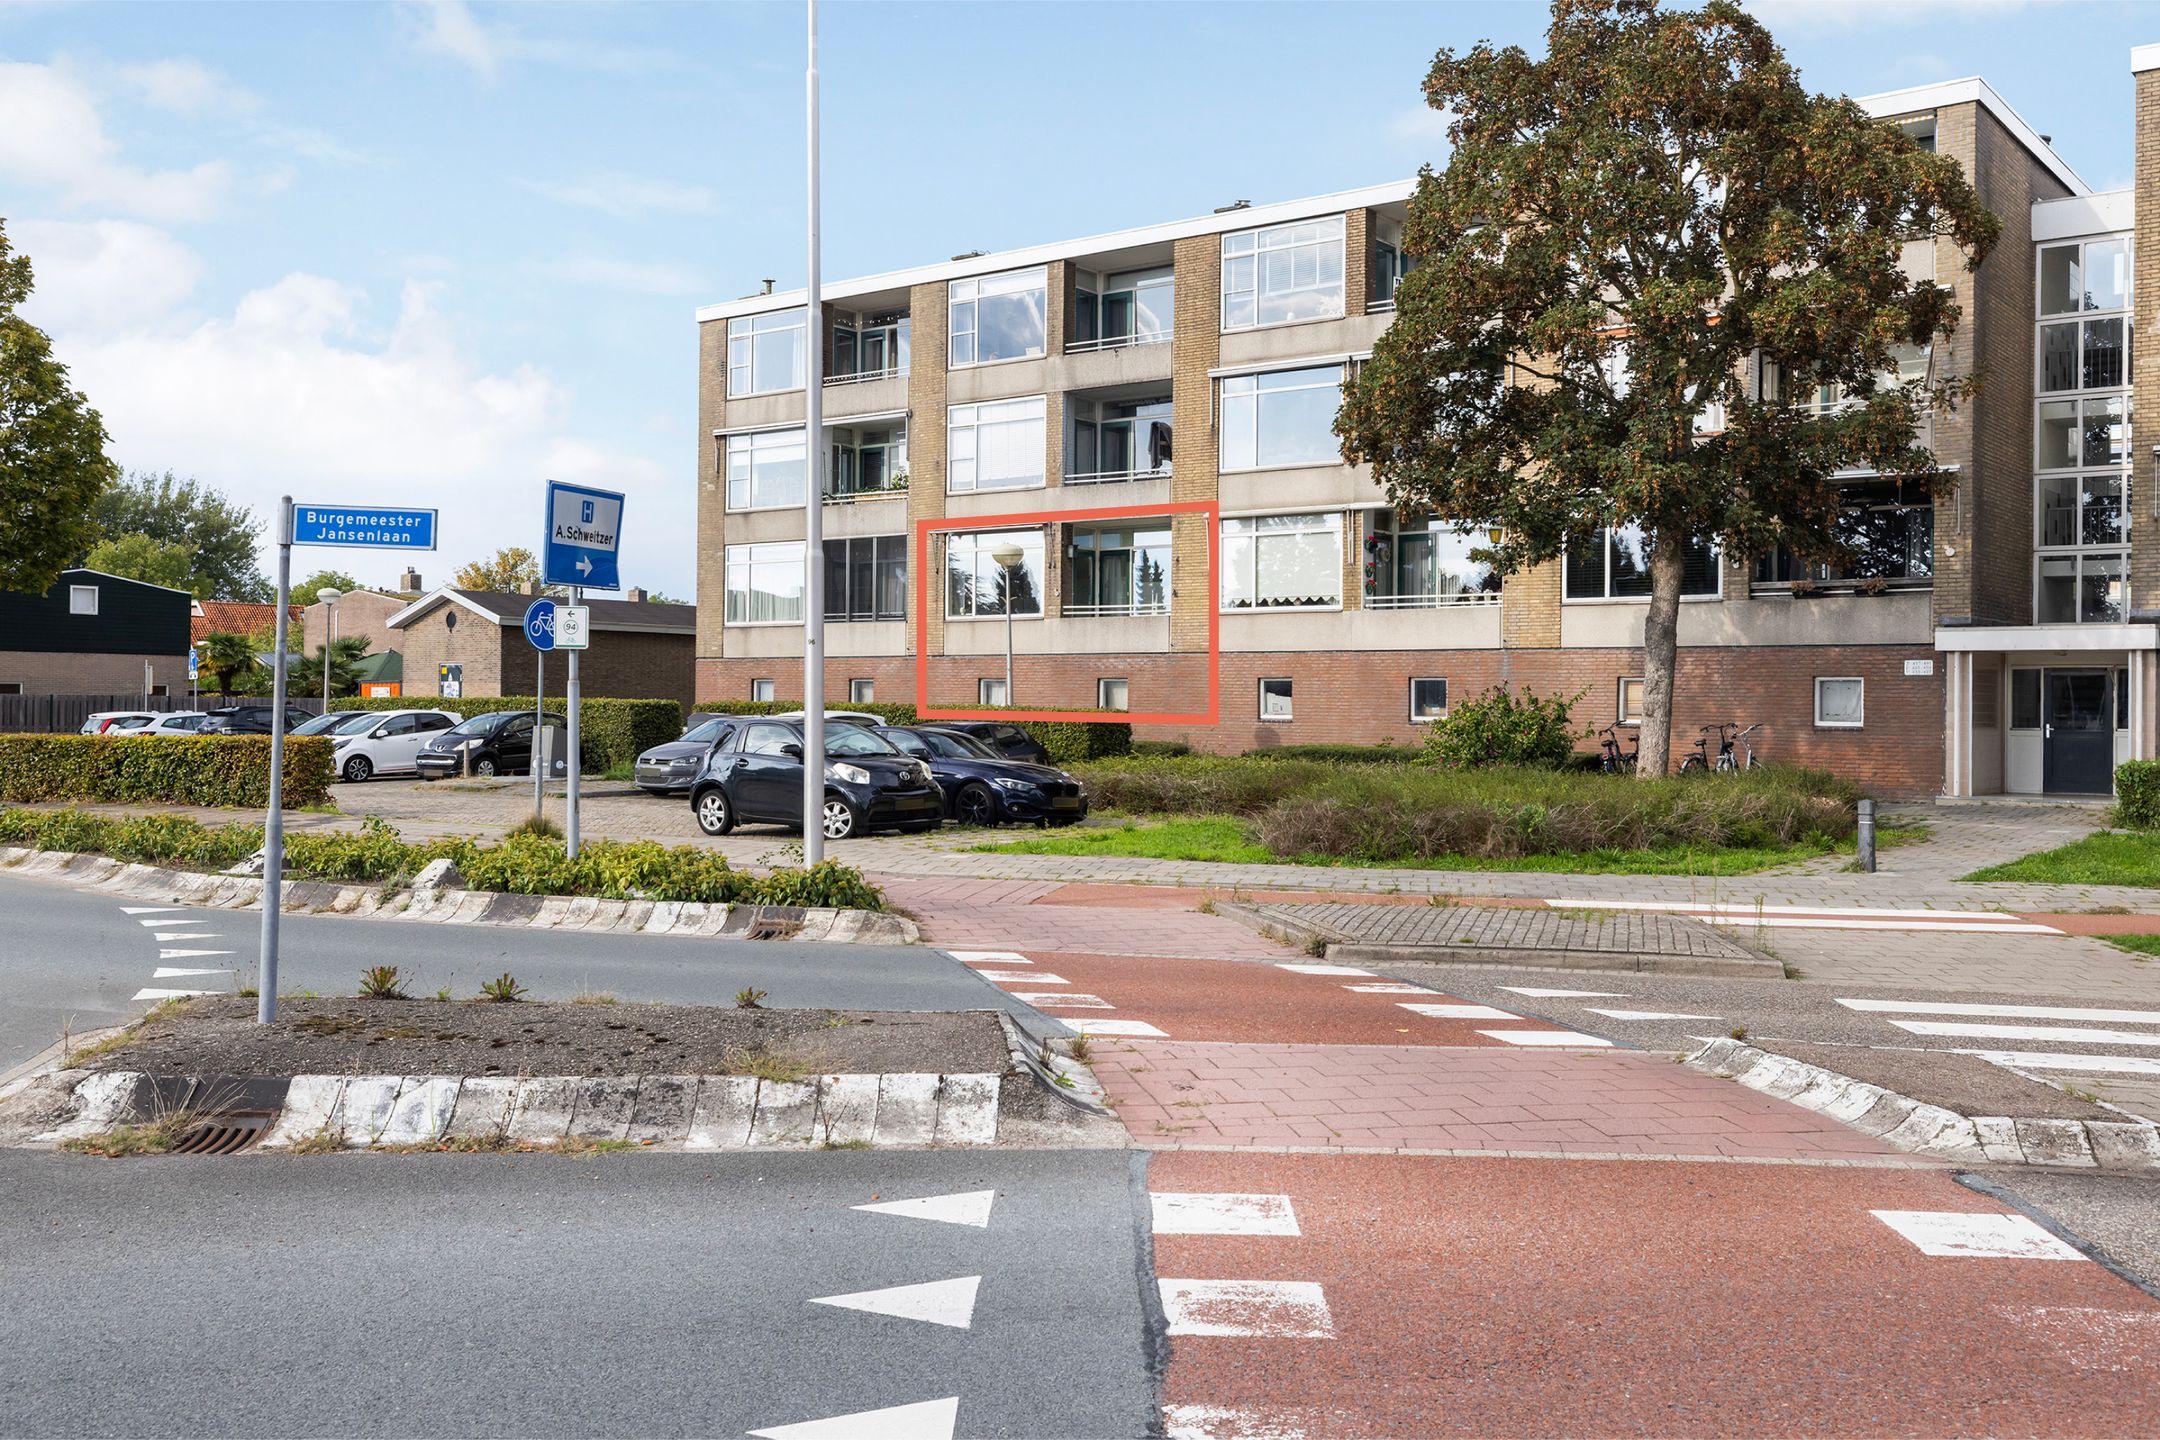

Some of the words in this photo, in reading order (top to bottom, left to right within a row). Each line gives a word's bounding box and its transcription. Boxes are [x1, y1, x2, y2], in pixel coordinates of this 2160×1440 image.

[307, 511, 421, 527] Burgemeester
[583, 502, 592, 521] H
[317, 527, 411, 542] Jansenlaan
[565, 623, 576, 631] 94
